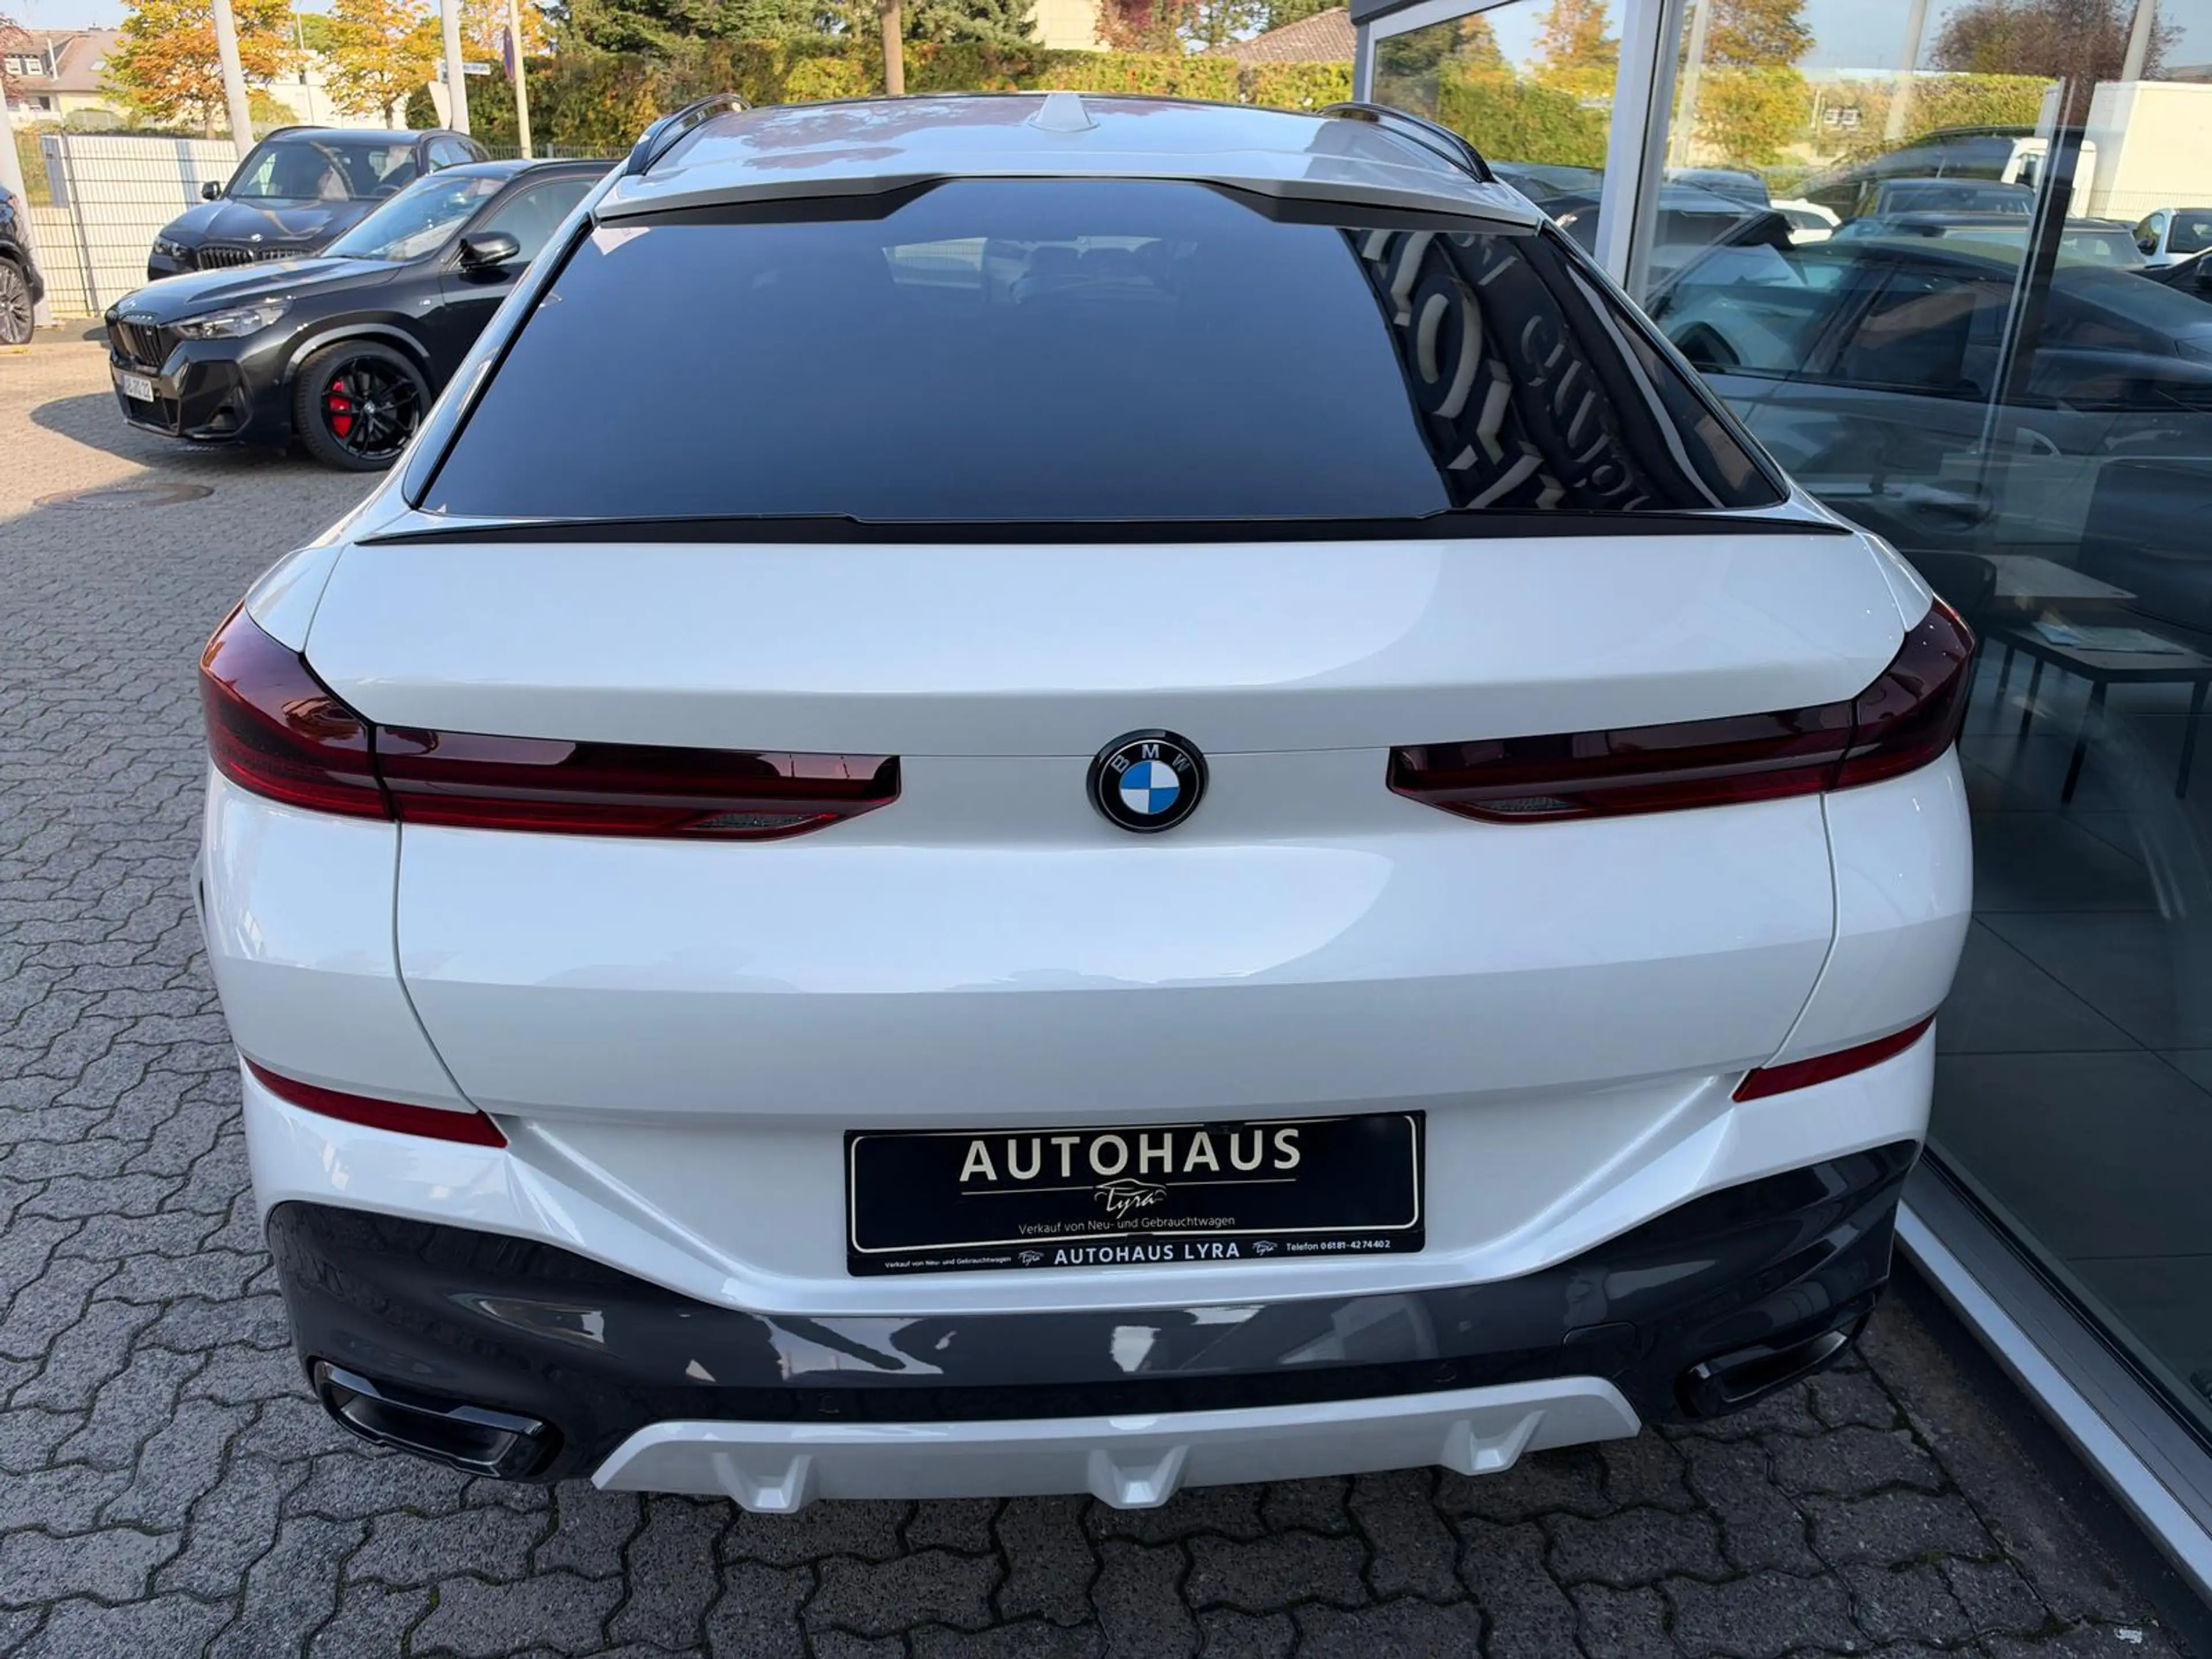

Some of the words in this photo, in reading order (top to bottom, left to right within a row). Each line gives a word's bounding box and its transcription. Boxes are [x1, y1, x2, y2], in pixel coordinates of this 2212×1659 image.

[1111, 744, 1191, 774] BMW
[959, 1128, 1301, 1182] AUTOHAUS
[1106, 1187, 1156, 1219] Lyra
[1018, 1222, 1062, 1235] Verkauf
[1065, 1222, 1085, 1232] von
[1088, 1220, 1115, 1230] Neu-
[1117, 1218, 1139, 1229] und
[1141, 1216, 1235, 1228] Gebrauchtwagen
[1054, 1245, 1174, 1265] AUTOHAUS
[1184, 1242, 1240, 1260] LYRA
[1286, 1242, 1319, 1251] Telefon
